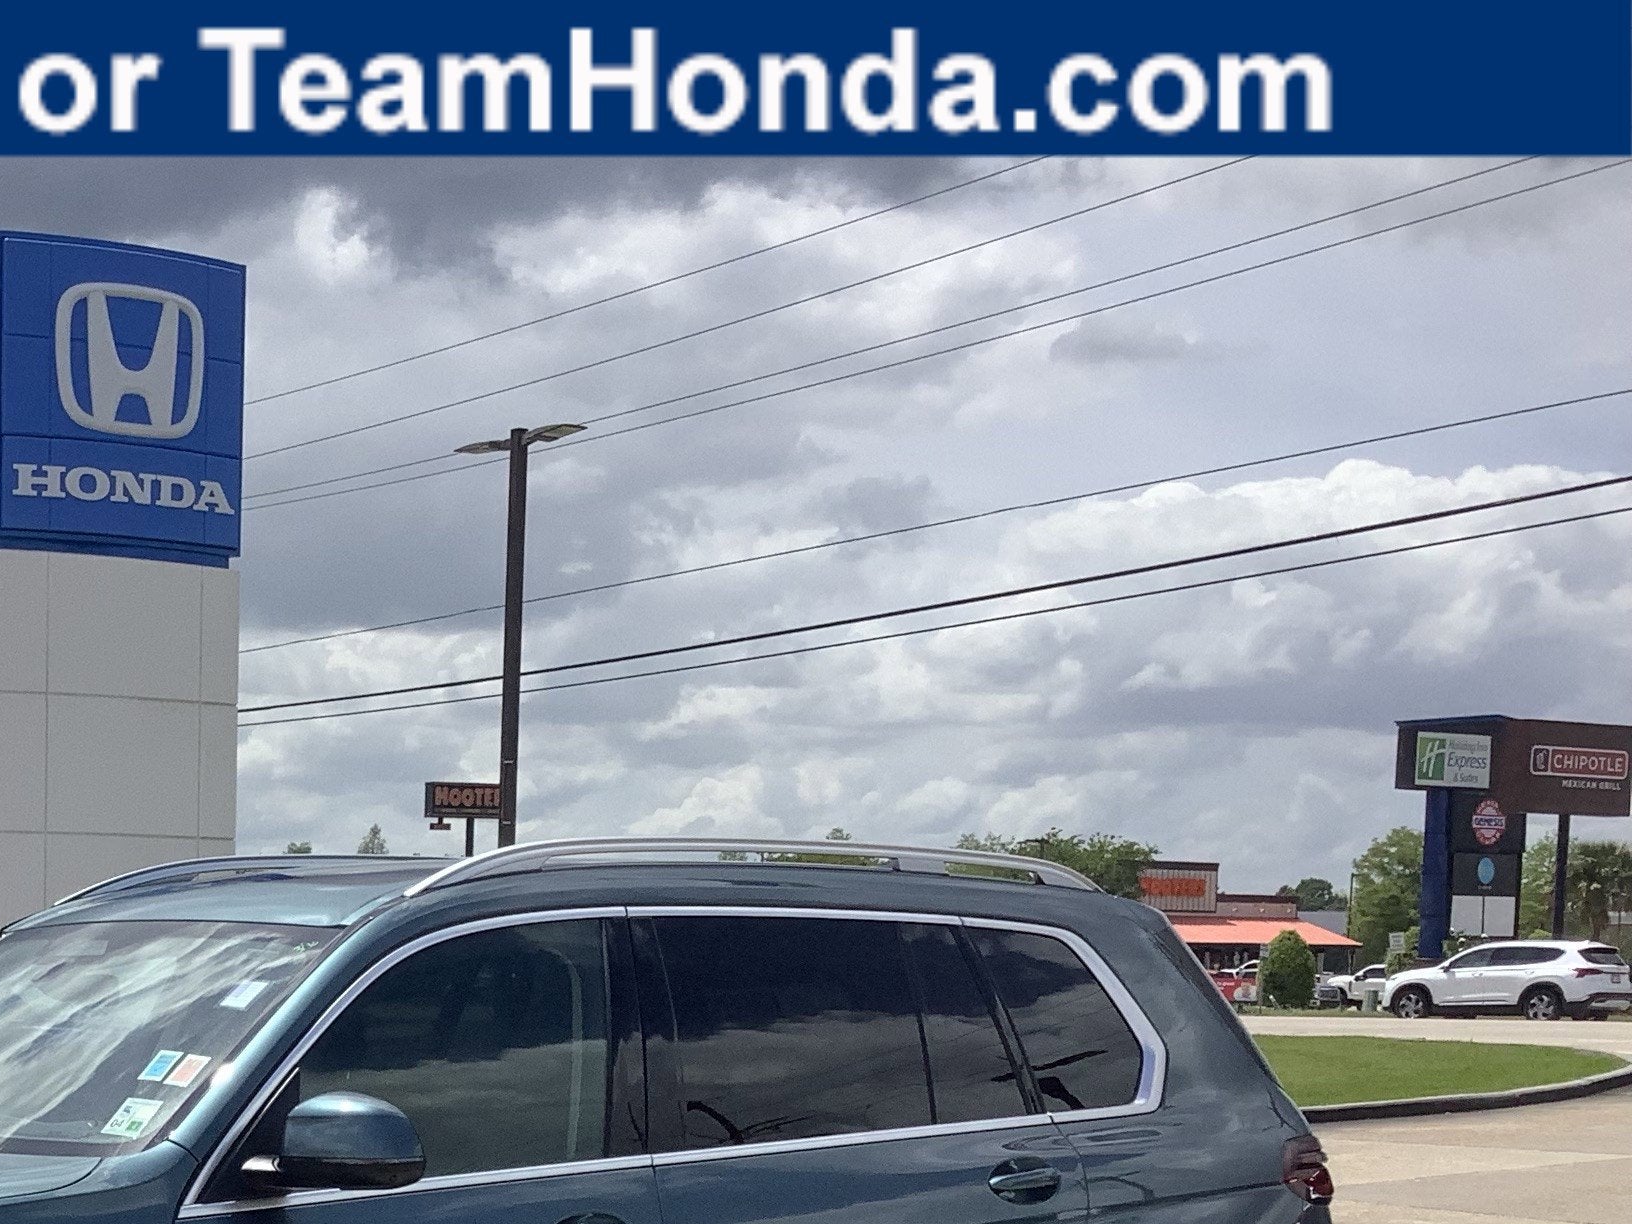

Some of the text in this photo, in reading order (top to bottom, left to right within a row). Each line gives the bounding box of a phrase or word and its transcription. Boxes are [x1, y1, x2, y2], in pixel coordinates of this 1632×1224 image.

[12, 463, 235, 516] HONDA
[1448, 751, 1487, 770] Express
[1553, 754, 1624, 773] CHIPOTLE
